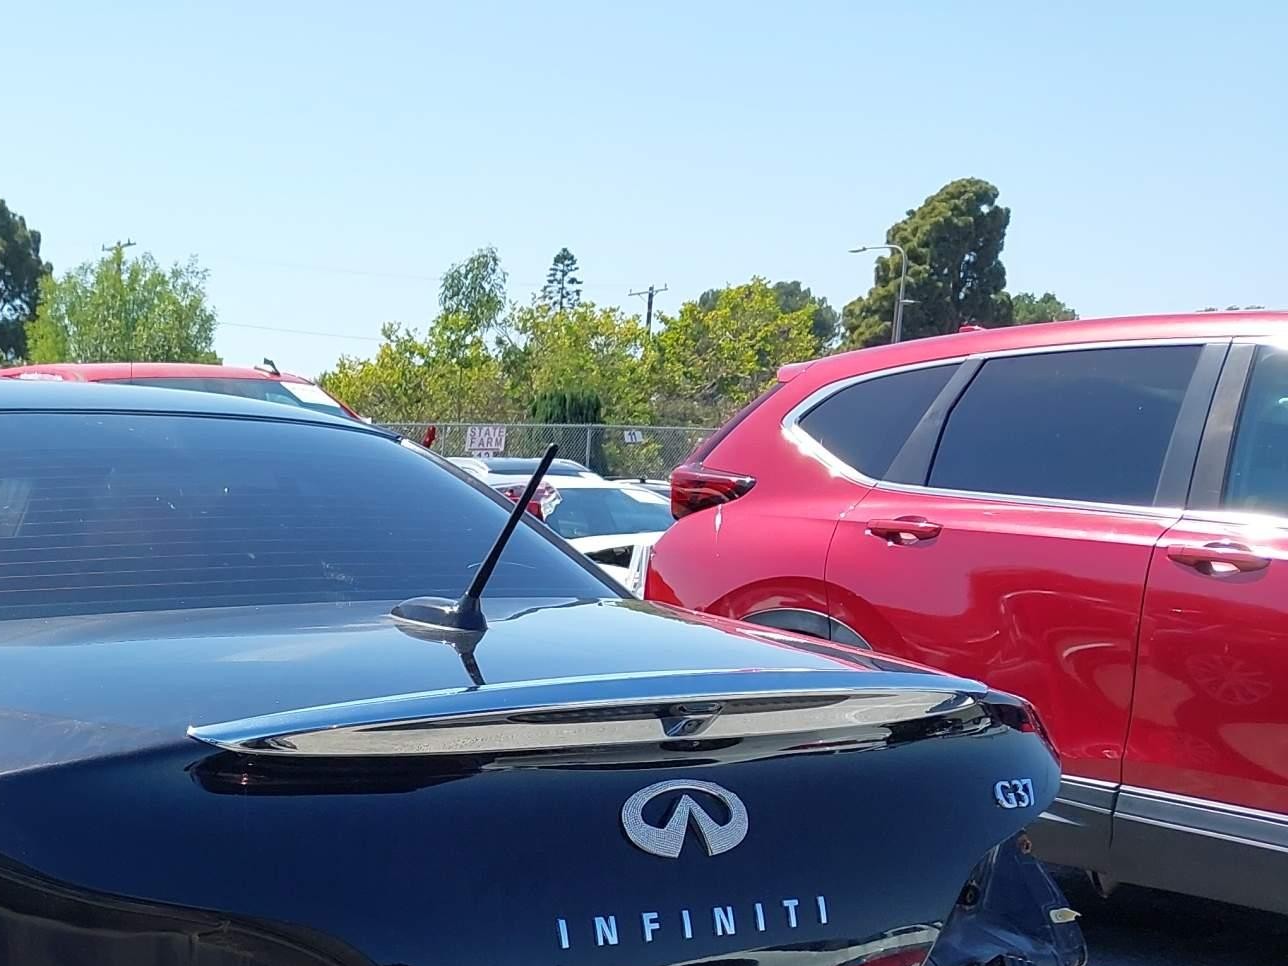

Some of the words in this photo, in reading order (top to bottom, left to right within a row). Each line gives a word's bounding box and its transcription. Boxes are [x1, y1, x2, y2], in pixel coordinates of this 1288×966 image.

[469, 426, 505, 437] STATE
[627, 431, 638, 442] 11
[469, 437, 503, 448] FARM
[994, 778, 1035, 809] G37
[557, 895, 828, 949] INFINITI
